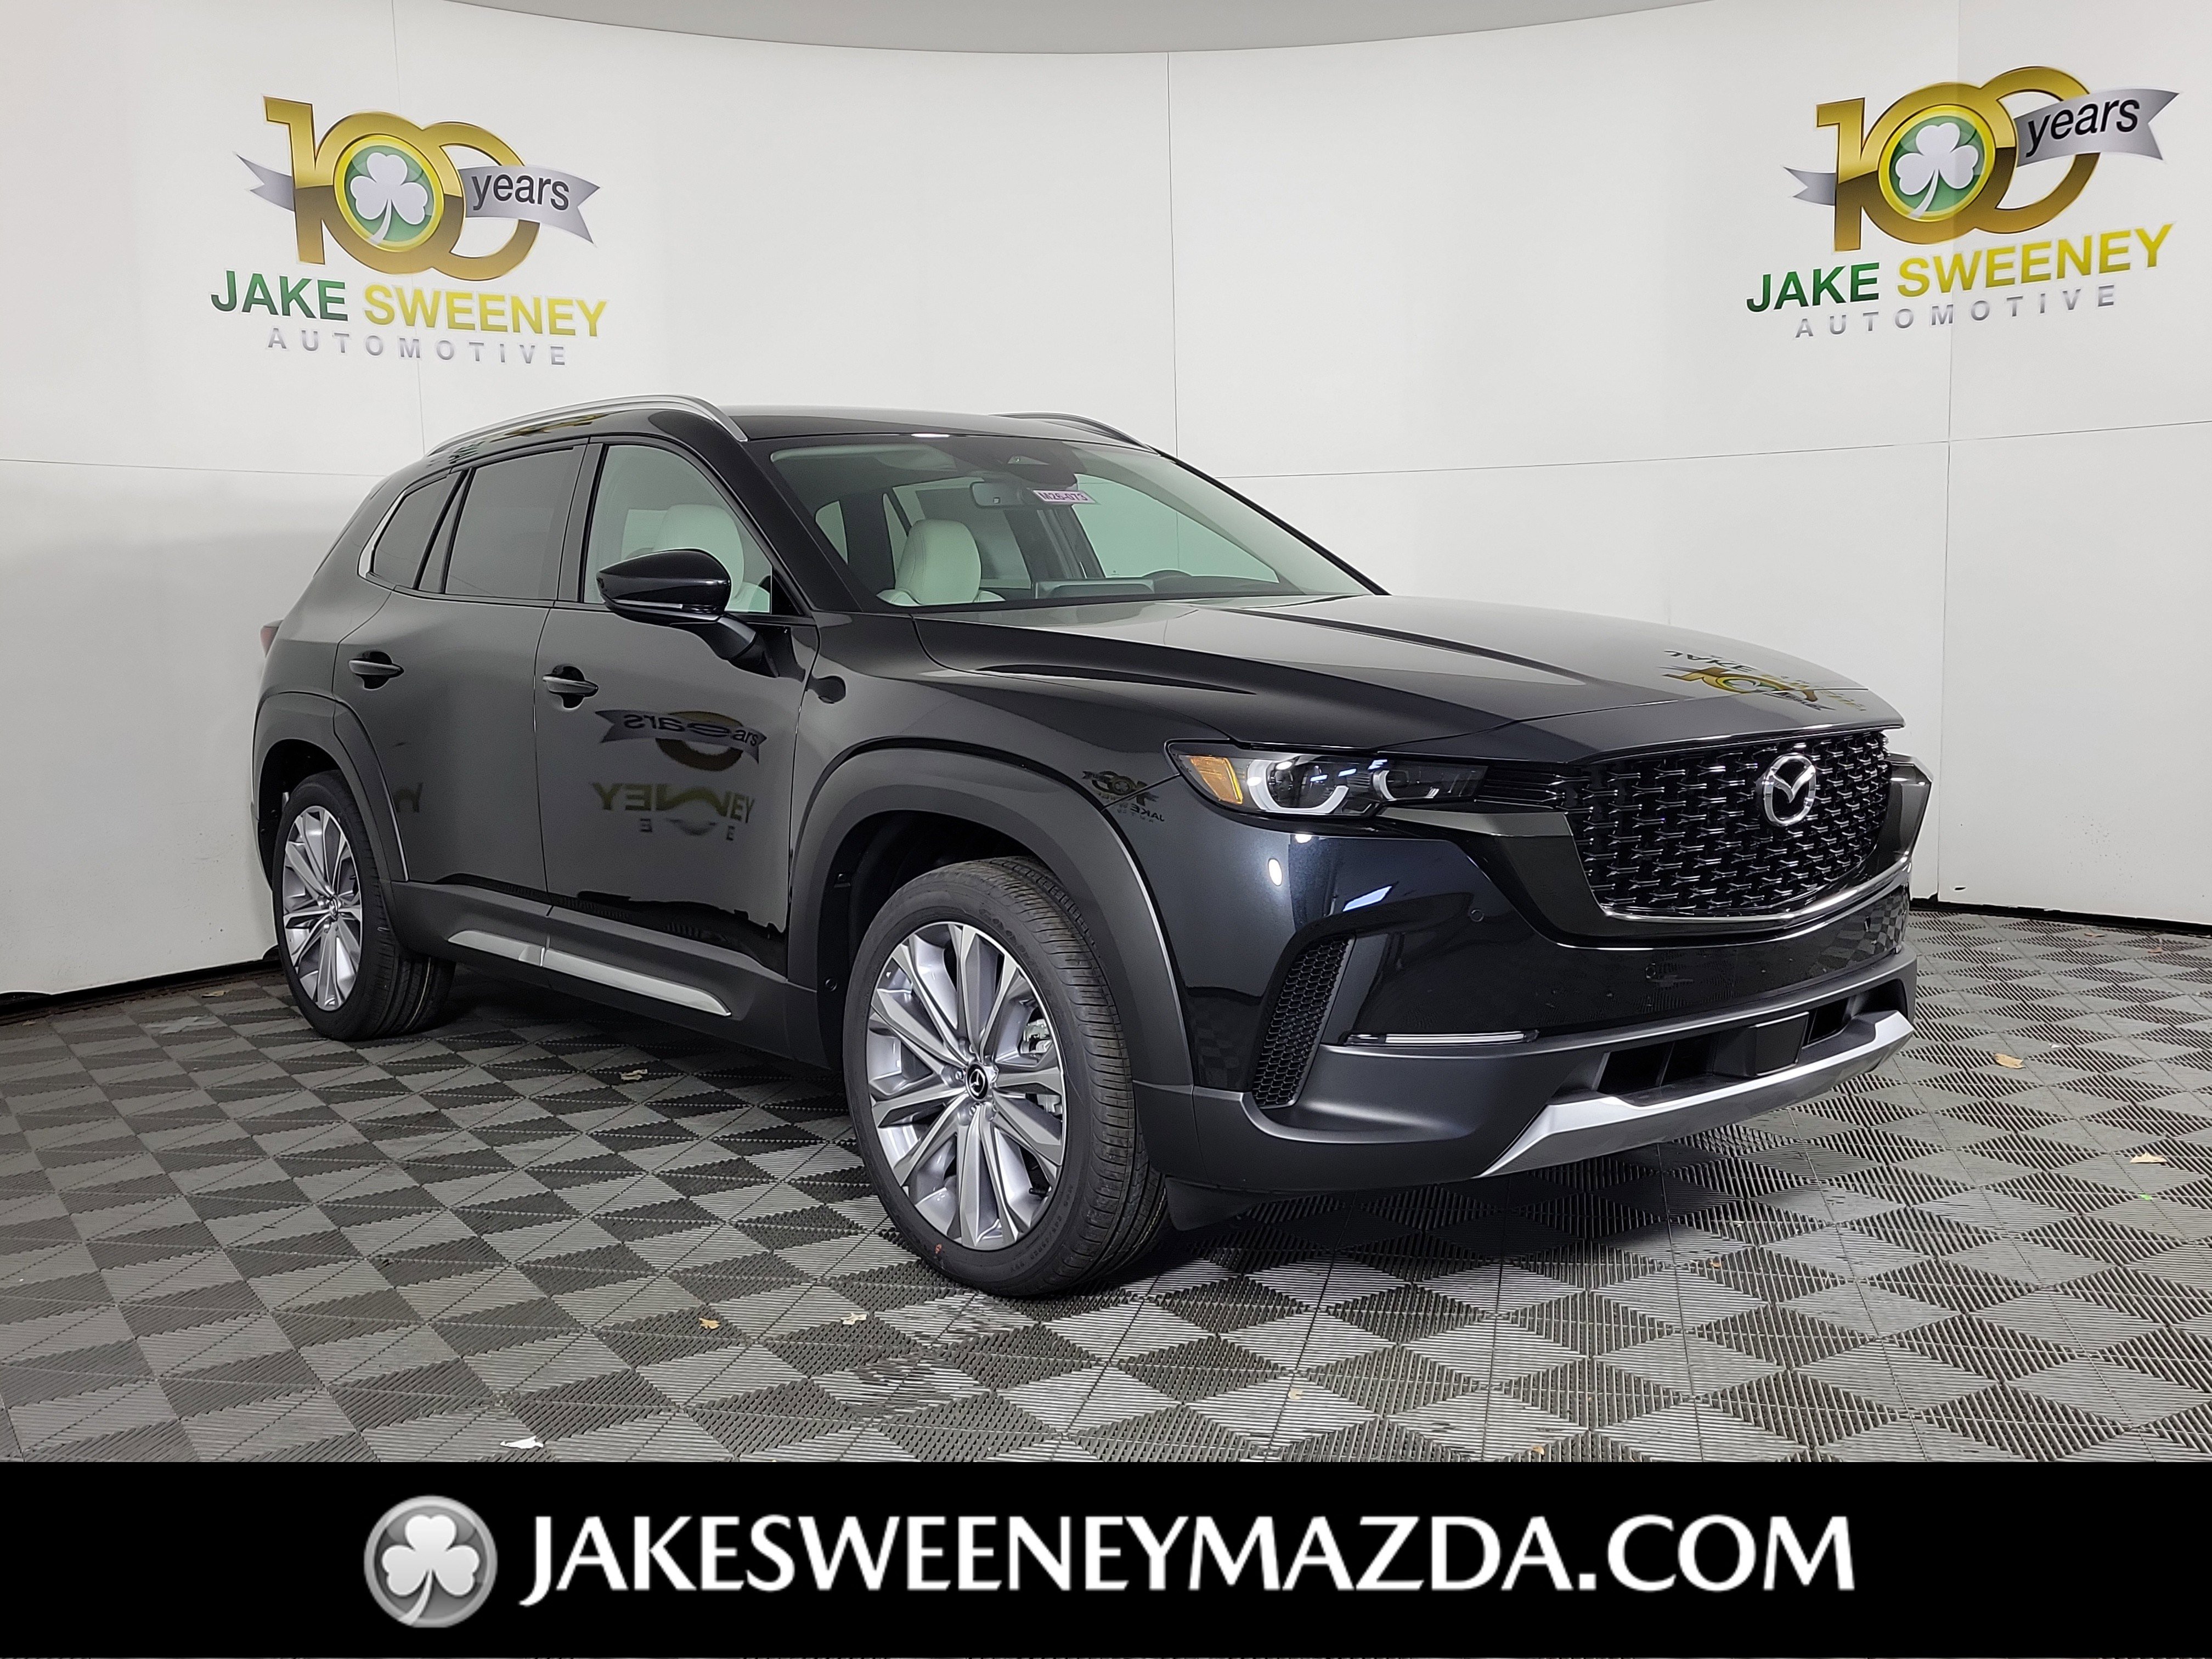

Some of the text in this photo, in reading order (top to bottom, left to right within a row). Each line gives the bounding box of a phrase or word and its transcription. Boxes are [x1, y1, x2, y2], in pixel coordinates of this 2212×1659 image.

[2025, 99, 2140, 157] years
[472, 172, 569, 211] years
[1746, 223, 2174, 313] JAKE SWEENEY
[211, 270, 607, 337] JAKE SWEENEY
[1795, 284, 2114, 338] AUTOMOTIVE
[267, 328, 565, 365] AUTOMOTIVE
[1038, 492, 1088, 501] M26-073
